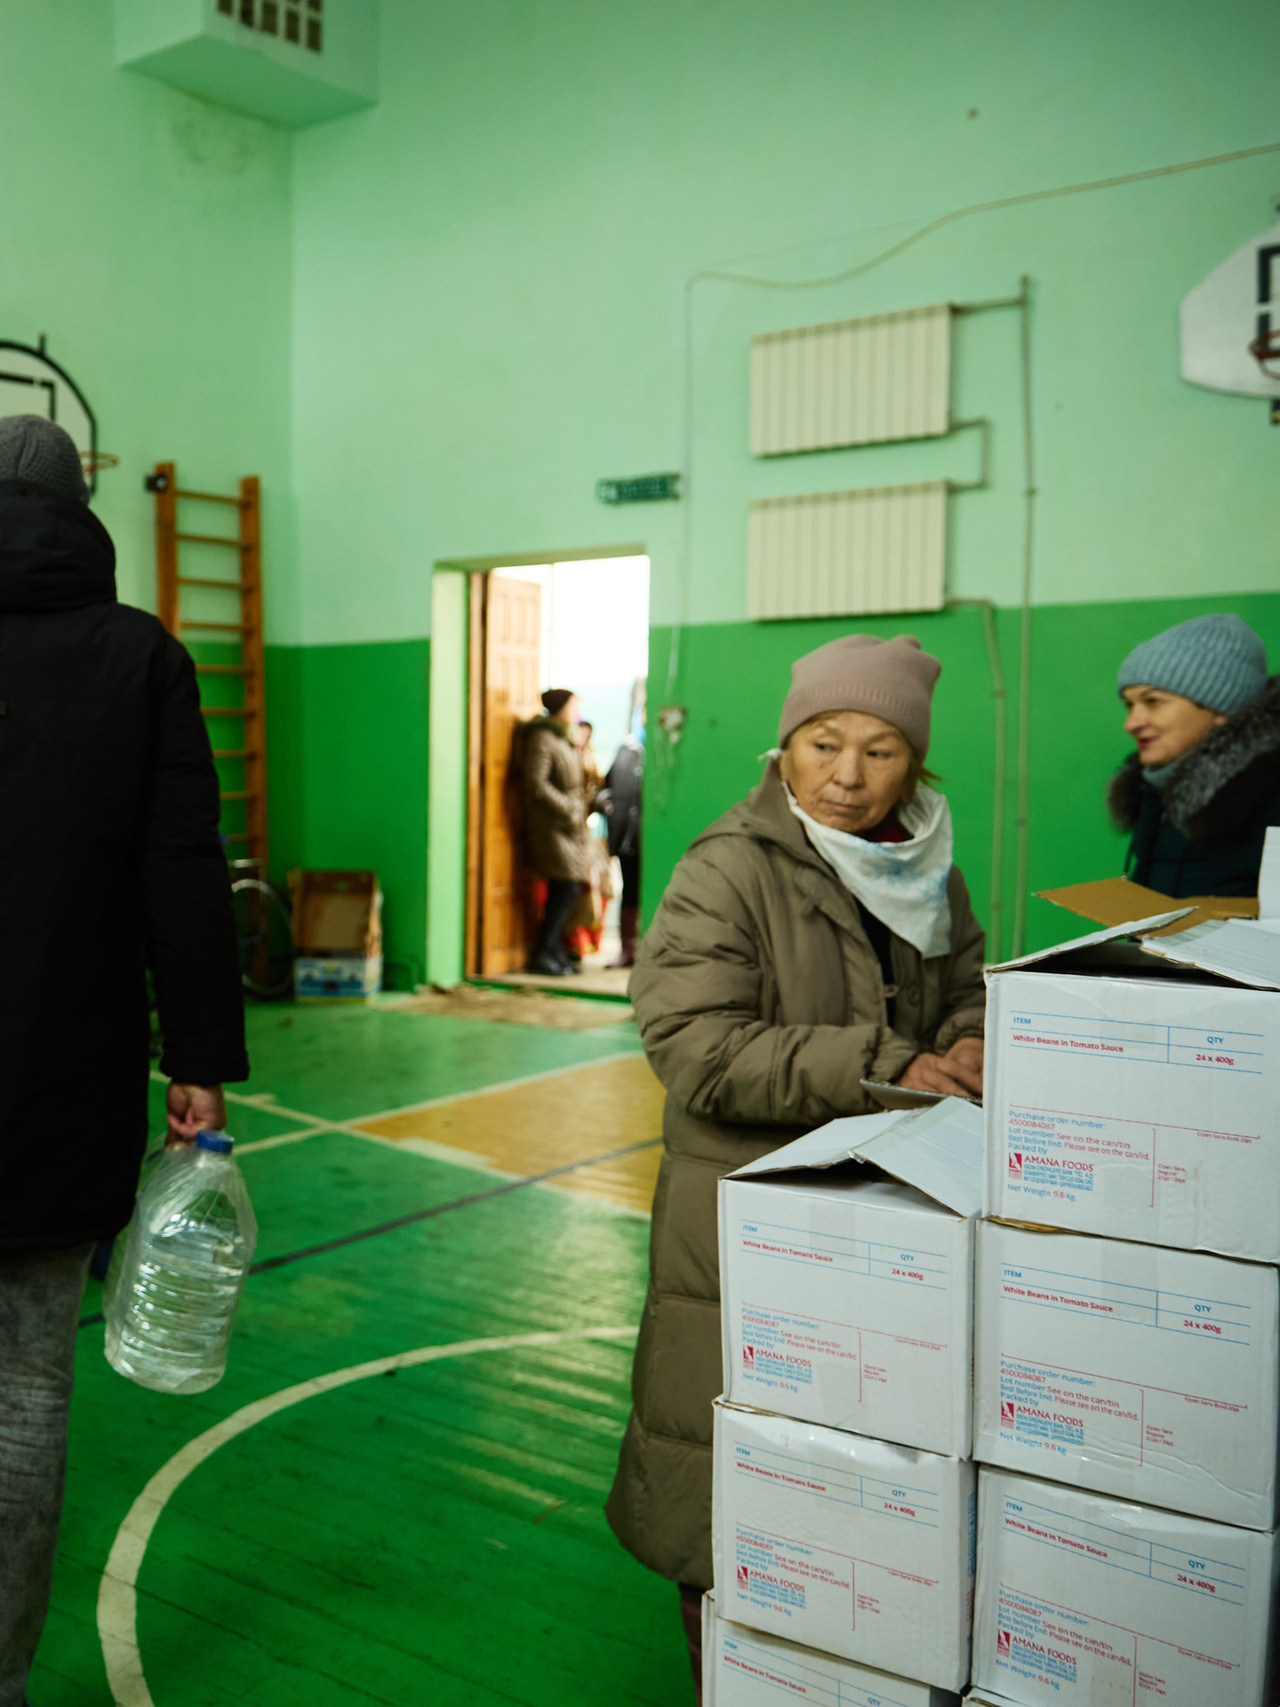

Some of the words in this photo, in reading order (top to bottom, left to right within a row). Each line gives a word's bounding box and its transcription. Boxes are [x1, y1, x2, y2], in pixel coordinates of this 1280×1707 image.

[1013, 1034, 1035, 1043] White
[1070, 1041, 1099, 1049] Tomato
[1101, 1044, 1124, 1052] Sauce
[1207, 1036, 1224, 1044] QTY
[1215, 1056, 1234, 1066] 400g
[1009, 1110, 1045, 1121] Purchase
[1047, 1116, 1068, 1124] order
[1008, 1134, 1022, 1142] Best
[1024, 1136, 1046, 1146] Before
[1064, 1142, 1086, 1151] Please
[1112, 1148, 1123, 1156] the
[1008, 1142, 1036, 1152] Packed
[1038, 1146, 1048, 1155] by
[1086, 1136, 1099, 1145] the
[1102, 1139, 1130, 1149] can/tin
[1025, 1156, 1059, 1167] AMANA
[1063, 1160, 1093, 1172] FOODS
[1024, 1186, 1051, 1197] Weight
[1054, 1190, 1064, 1198] 9.6
[1066, 1193, 1075, 1202] kg
[1005, 1269, 1022, 1277] ITEM
[1004, 1286, 1025, 1296] White
[1027, 1291, 1049, 1301] Beans
[1061, 1297, 1088, 1308] Tomato
[1091, 1303, 1113, 1312] Sauce
[1194, 1304, 1211, 1312] QTY
[1184, 1320, 1193, 1328] 24
[1203, 1324, 1221, 1335] 400g
[1001, 1360, 1036, 1373] Purchase
[1038, 1369, 1059, 1379] order
[1001, 1376, 1012, 1384] Lot
[1048, 1386, 1062, 1395] See
[1076, 1392, 1089, 1401] the
[1092, 1396, 1120, 1408] can/tin
[1001, 1391, 1027, 1403] Packed
[1029, 1398, 1039, 1407] by
[1001, 1384, 1014, 1393] Best
[1016, 1387, 1037, 1398] Before
[1055, 1396, 1076, 1406] Please
[1078, 1402, 1089, 1410] see
[1102, 1406, 1113, 1415] the
[1017, 1406, 1050, 1420] AMANA
[1054, 1414, 1083, 1427] FOODS
[1000, 1432, 1013, 1440] Net
[1016, 1435, 1042, 1448] Weight
[1045, 1442, 1056, 1451] 9.6
[1058, 1445, 1066, 1455] kg
[1006, 1503, 1022, 1512] ITEM
[1005, 1519, 1025, 1531] White
[1027, 1526, 1047, 1538] Beans
[1050, 1533, 1056, 1541] in
[1059, 1536, 1085, 1550] Tomato
[1087, 1545, 1109, 1557] Sauce
[1188, 1559, 1205, 1569] QTY
[1178, 1574, 1187, 1582] 24
[1196, 1580, 1214, 1593] 400g
[999, 1590, 1032, 1607] Purchase
[1034, 1603, 1054, 1615] order
[998, 1605, 1009, 1614] Lot
[1043, 1621, 1057, 1631] See
[1059, 1627, 1069, 1635] on
[1071, 1630, 1083, 1641] the
[1086, 1636, 1113, 1652] can/tin
[998, 1620, 1023, 1634] Packed
[1025, 1629, 1034, 1639] by
[1012, 1636, 1045, 1654] AMANA
[1048, 1648, 1077, 1665] FOODS
[996, 1659, 1008, 1669] Net
[1011, 1664, 1036, 1681] Weight
[1039, 1674, 1049, 1684] 9.6
[1051, 1680, 1059, 1690] kg
